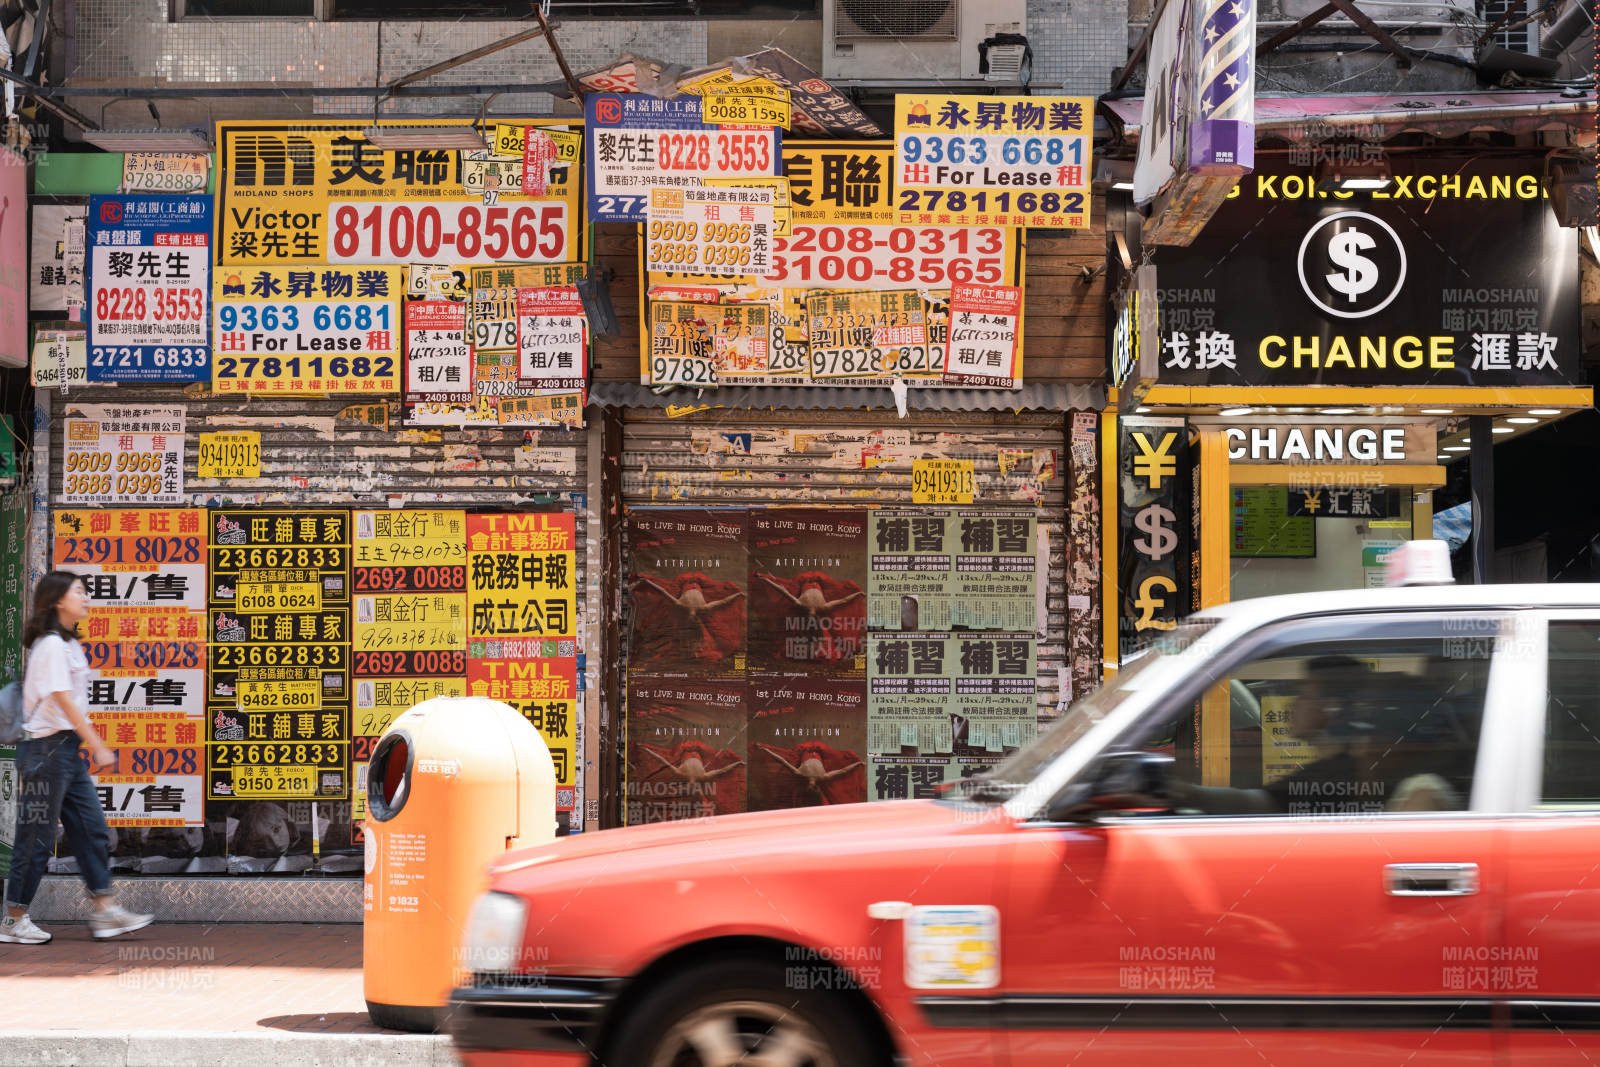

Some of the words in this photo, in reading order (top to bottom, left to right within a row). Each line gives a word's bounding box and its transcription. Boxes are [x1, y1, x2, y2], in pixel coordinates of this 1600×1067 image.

[710, 106, 747, 119] 9088
[753, 107, 785, 122] 1595
[937, 101, 1083, 131] 永昇物業
[599, 133, 655, 163] 黎先生
[658, 133, 710, 171] 8228
[717, 135, 769, 171] 3553
[904, 137, 987, 164] 9363
[1002, 138, 1082, 165] 6681
[125, 172, 203, 189] 97828882
[904, 164, 930, 184] 出
[937, 166, 974, 185] For
[984, 167, 1052, 186] Lease
[1056, 166, 1083, 186] 租
[685, 190, 770, 203] 筍盤地產有限公司
[899, 190, 1084, 213] 27811682
[231, 207, 321, 229] Victor
[704, 205, 720, 221] 租
[739, 206, 756, 221] 售
[96, 231, 141, 245] 真盤源
[333, 204, 565, 258] 8100-8565
[649, 220, 697, 241] 9609
[703, 223, 751, 243] 9966
[231, 231, 319, 258] 梁先生
[649, 242, 697, 263] 3686
[703, 245, 751, 266] 0396
[108, 252, 190, 278] 黎先生
[252, 272, 389, 299] 永昇物業
[97, 288, 146, 321] 8228
[153, 288, 203, 321] 3553
[220, 305, 299, 331] 9363
[313, 305, 389, 331] 6681
[221, 333, 245, 352] 出
[251, 334, 291, 351] For
[296, 334, 362, 351] Lease
[366, 332, 392, 351] 租
[1259, 335, 1456, 369] CHANGE
[92, 348, 142, 367] 2721
[153, 348, 206, 367] 6833
[218, 358, 394, 377] 27811682
[530, 352, 573, 369] 租/售
[958, 348, 1003, 367] 租/售
[418, 366, 461, 383] 租/售
[537, 380, 559, 388] 2409
[562, 380, 585, 388] 0188
[962, 375, 987, 386] 2409
[988, 377, 1013, 388] 0188
[425, 393, 447, 402] 2409
[450, 393, 471, 402] 0188
[102, 423, 181, 432] 筍盤地產有限公司
[119, 435, 133, 450] 租
[152, 435, 167, 450] 售
[1227, 428, 1406, 461] CHANGE
[66, 452, 112, 472] 9609
[116, 452, 162, 472] 9966
[201, 443, 260, 467] 93419313
[65, 474, 111, 494] 3686
[116, 474, 162, 494] 0396
[914, 469, 974, 492] 93419313
[250, 517, 342, 543] 旺舖專家
[375, 513, 429, 538] 國金行
[481, 515, 562, 531] TML
[654, 522, 673, 530] LIVE
[677, 523, 686, 531] IN
[690, 525, 713, 533] HONG
[717, 525, 741, 535] KONG
[774, 521, 793, 530] LIVE
[797, 522, 805, 530] IN
[810, 523, 833, 532] HONG
[838, 524, 861, 534] KONG
[471, 531, 568, 550] 會計事務所
[876, 518, 945, 552] 補習
[960, 518, 1029, 552] 補習
[63, 538, 123, 563] 2391
[135, 537, 200, 563] 8028
[219, 549, 341, 568] 23662833
[656, 559, 721, 568] ATTRITION
[776, 558, 840, 567] ATTRITION
[356, 567, 407, 588] 2692
[414, 567, 464, 588] 0088
[241, 595, 276, 609] 6108
[279, 594, 316, 608] 0624
[375, 596, 429, 622] 國金行
[472, 598, 568, 635] 成立公司
[250, 614, 342, 641] 旺舖專家
[135, 642, 199, 668] 8028
[218, 646, 341, 665] 23662833
[356, 652, 407, 674] 2692
[414, 651, 464, 673] 0088
[876, 640, 945, 675] 補習
[960, 640, 1029, 675] 補習
[482, 662, 563, 679] TML
[243, 693, 279, 707] 9482
[282, 692, 315, 706] 6801
[471, 680, 569, 699] 會計事務所
[654, 690, 672, 699] LIVE
[676, 692, 684, 700] IN
[689, 692, 712, 701] HONG
[717, 694, 740, 703] KONG
[774, 690, 792, 699] LIVE
[797, 692, 805, 700] IN
[809, 692, 833, 702] HONG
[837, 694, 861, 703] KONG
[249, 713, 341, 739] 旺舖專家
[656, 727, 720, 736] ATTRITION
[775, 727, 840, 736] ATTRITION
[131, 748, 197, 774] 8028
[217, 744, 339, 763] 23662833
[238, 777, 276, 791] 9150
[278, 777, 309, 790] 2181
[876, 765, 944, 800] 補習
